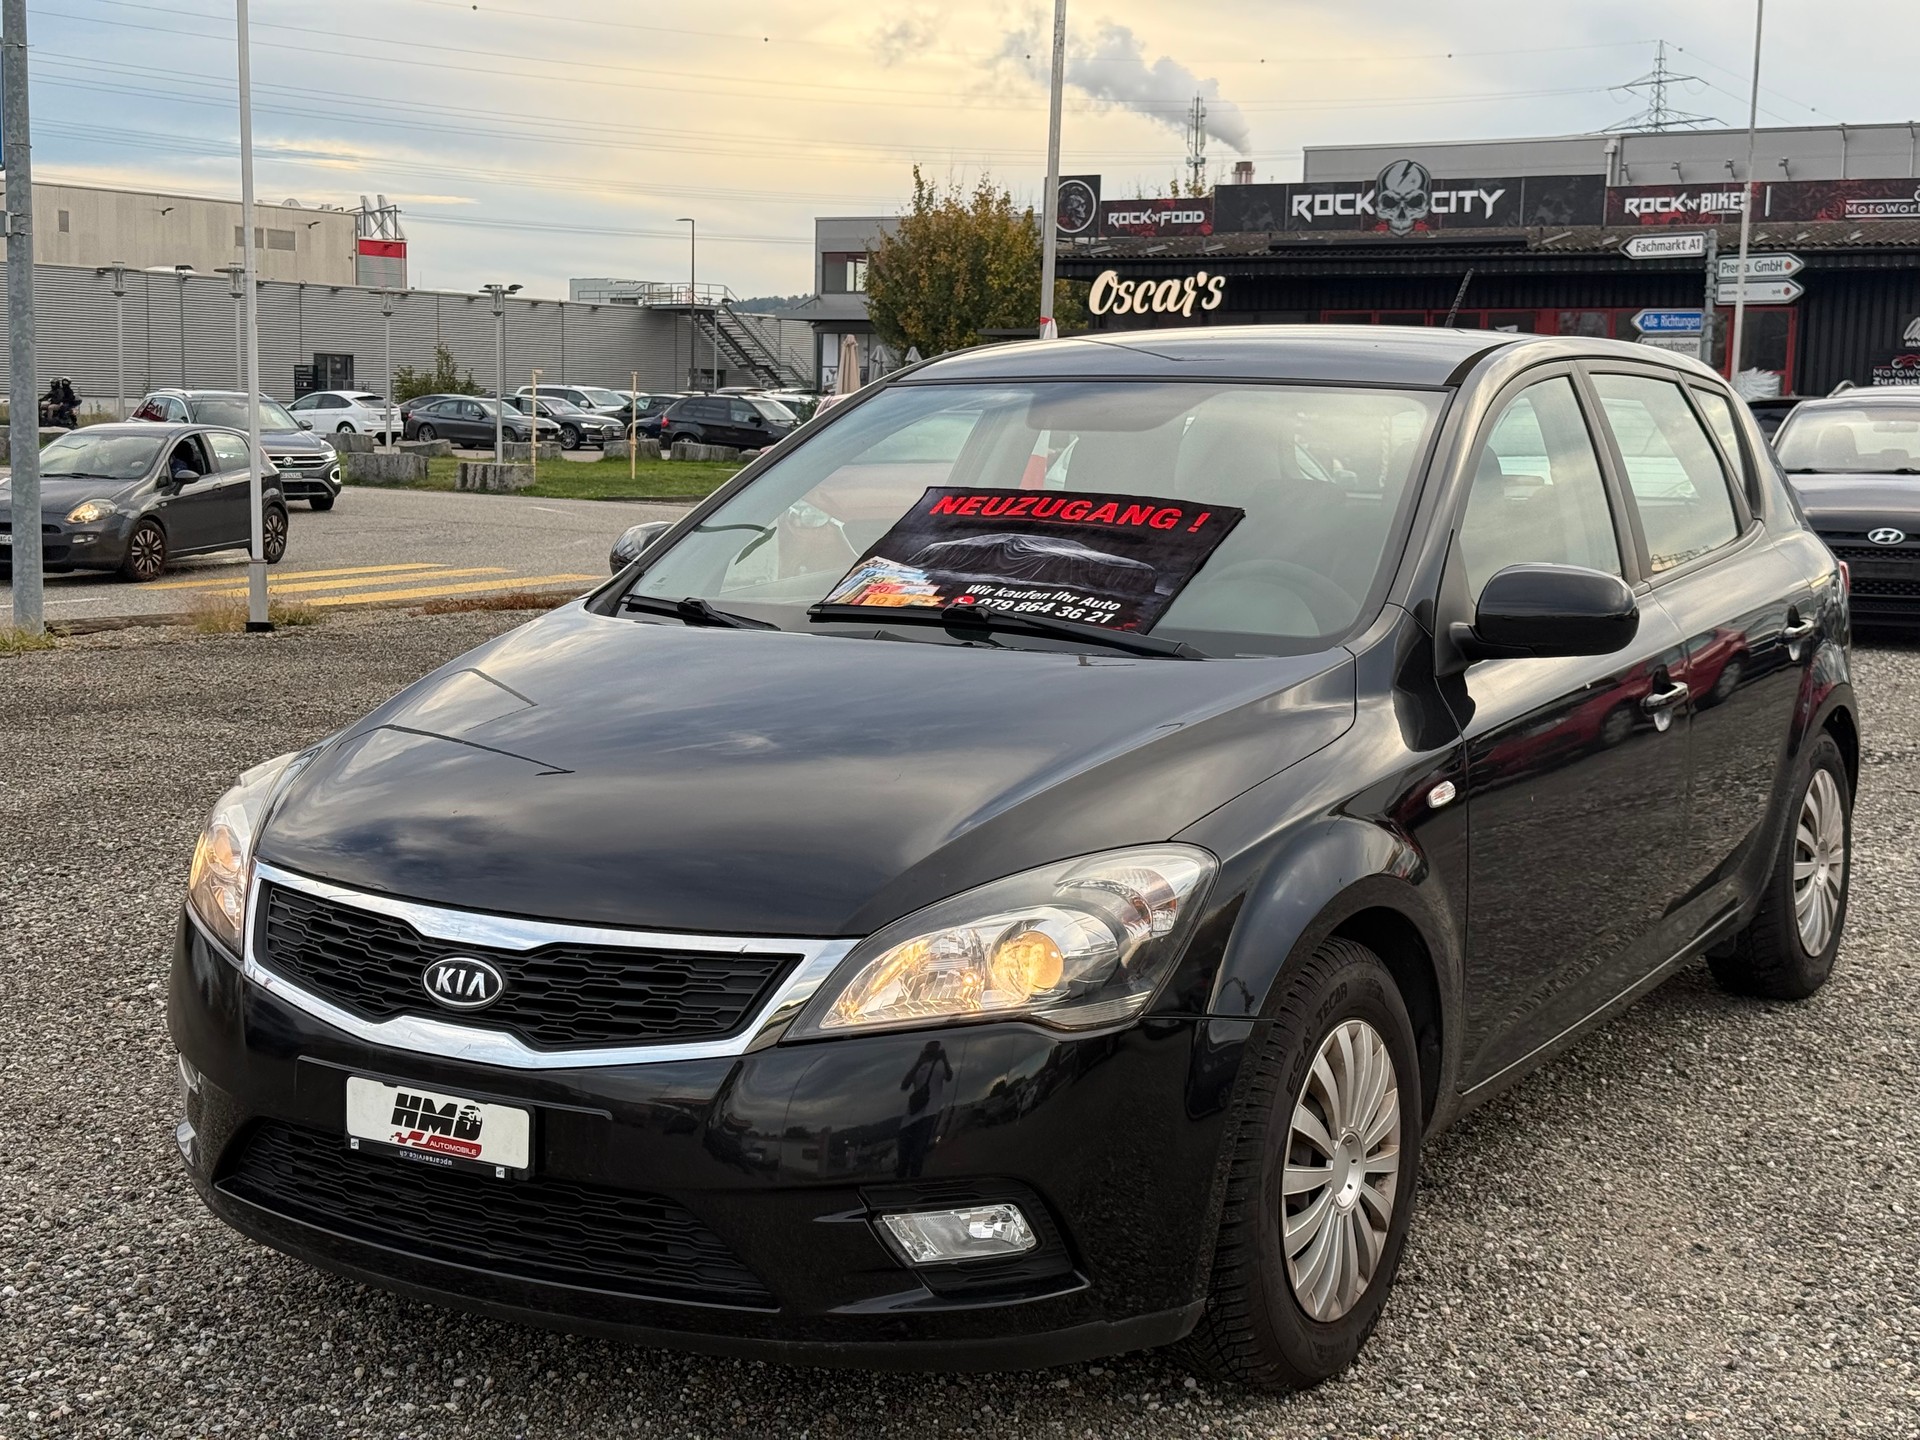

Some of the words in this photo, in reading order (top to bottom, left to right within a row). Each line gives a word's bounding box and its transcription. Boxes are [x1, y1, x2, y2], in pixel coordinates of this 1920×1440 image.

[1292, 188, 1375, 222] ROCK
[1430, 188, 1506, 219] CITY
[1636, 240, 1686, 252] Fachmarkt
[1688, 239, 1700, 250] A1
[1754, 260, 1782, 272] GmbH
[1088, 270, 1226, 318] Oscar's
[1644, 314, 1658, 327] Alle
[1660, 314, 1700, 330] Richtungen
[929, 495, 1182, 530] NEUZUGANG
[965, 584, 992, 595] Wir
[994, 587, 1051, 600] kaufen
[1051, 590, 1078, 604] Ihr
[1078, 596, 1122, 610] Auto
[1014, 600, 1056, 614] 864
[1055, 606, 1082, 620] 36
[1084, 612, 1114, 624] 21
[435, 966, 486, 998] KIA
[430, 1140, 476, 1156] AUTOMOBILE
